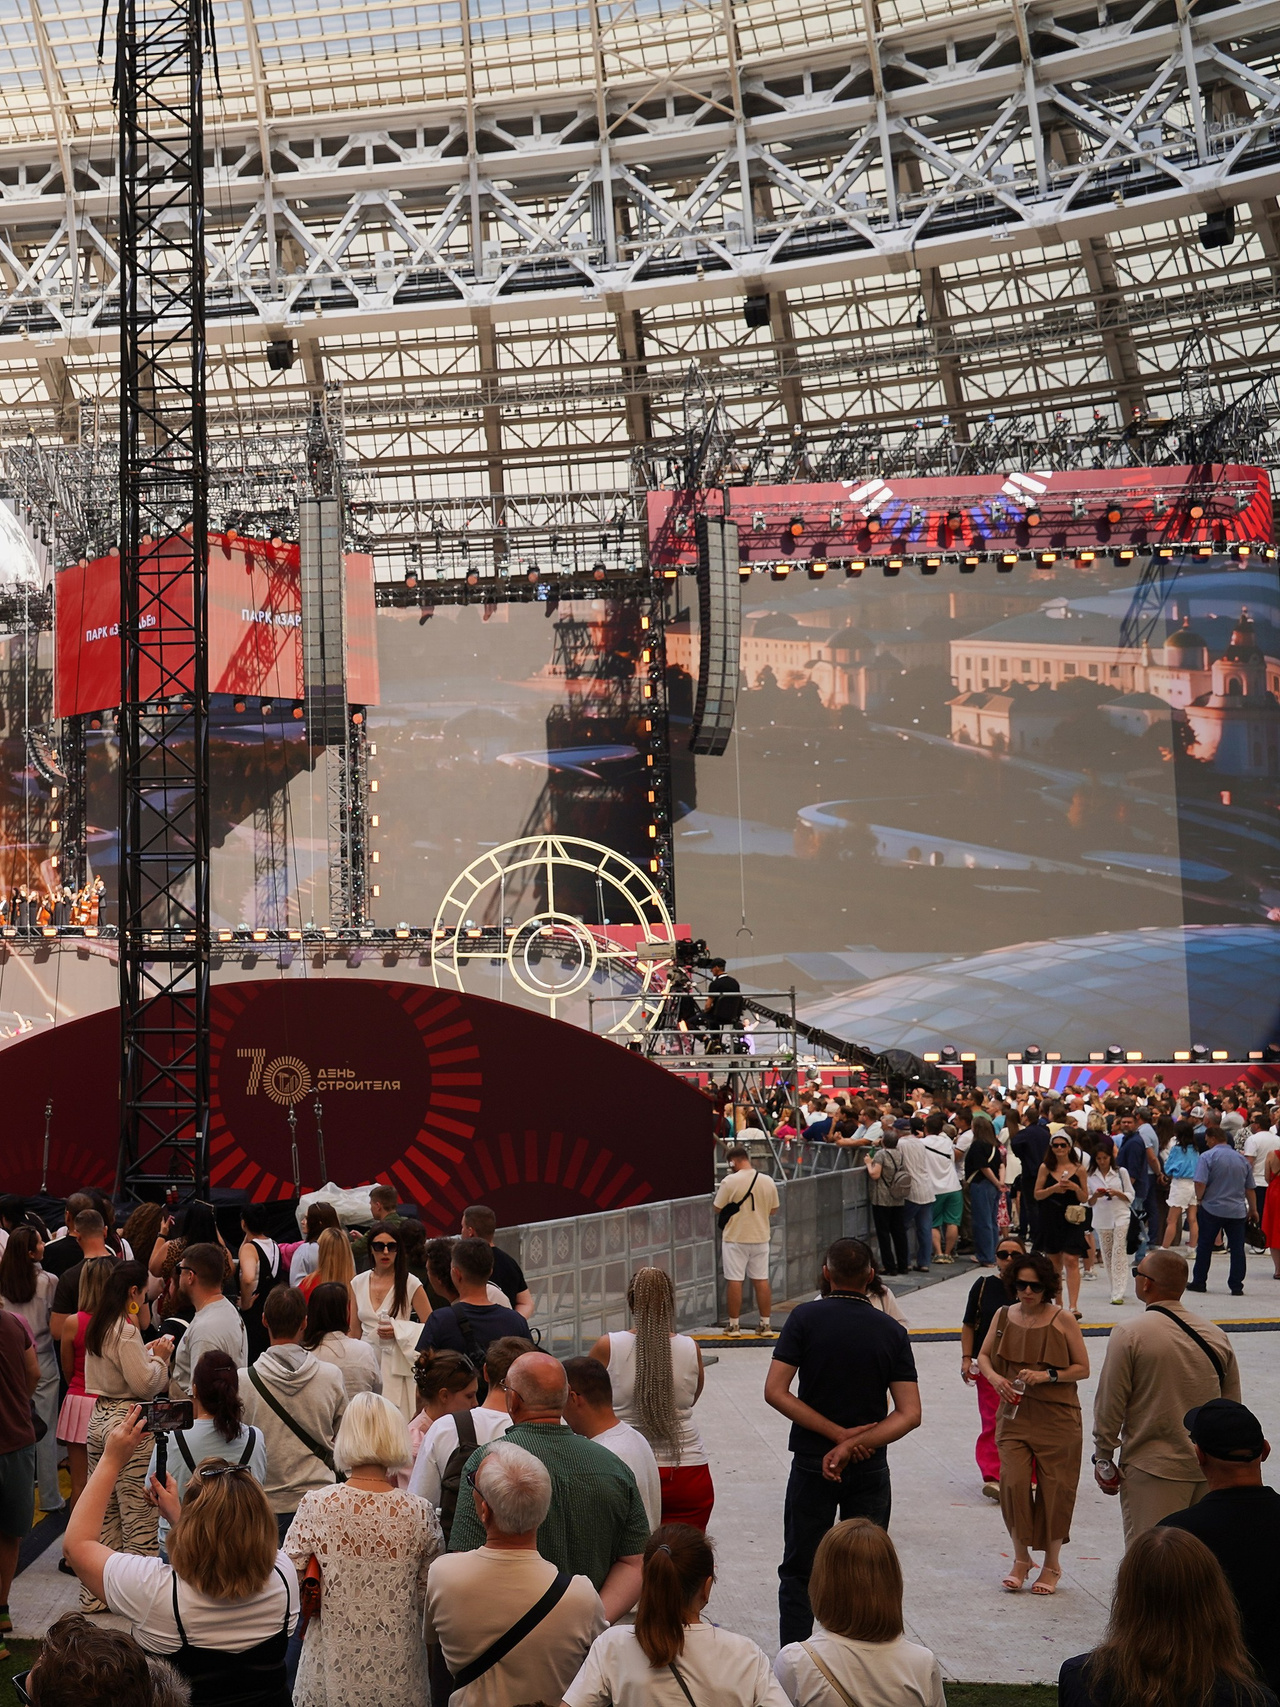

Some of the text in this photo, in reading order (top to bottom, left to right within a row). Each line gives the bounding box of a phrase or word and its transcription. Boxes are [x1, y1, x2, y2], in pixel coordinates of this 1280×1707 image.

[241, 608, 273, 625] ПАРК
[86, 626, 108, 642] ПАРК
[317, 1068, 356, 1079] ДЕНЬ
[317, 1080, 401, 1091] СТРОИТЕЛЯ
